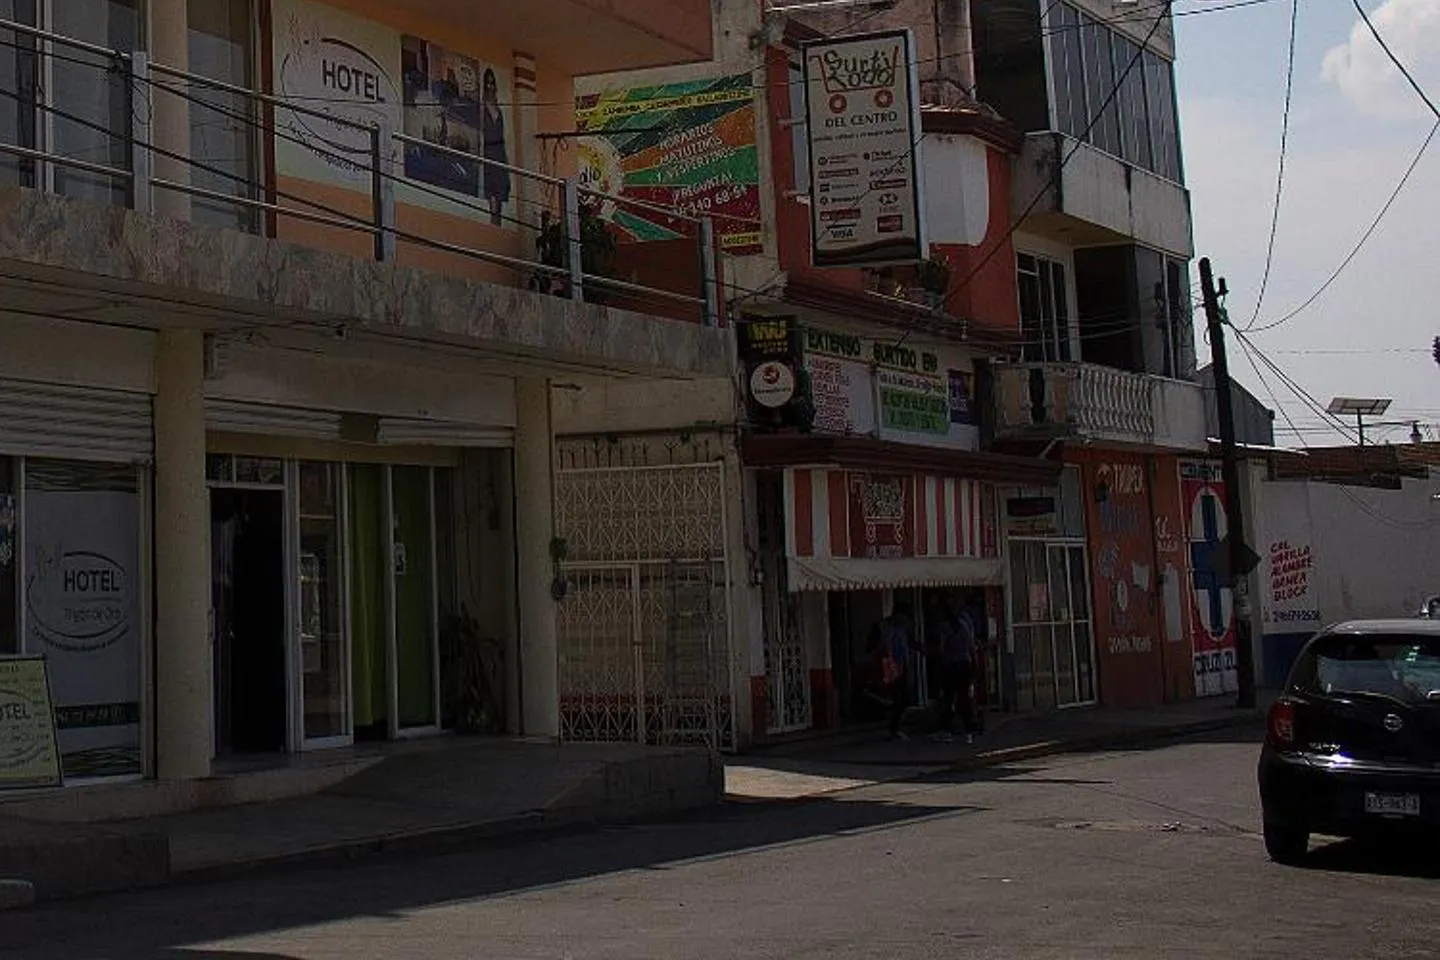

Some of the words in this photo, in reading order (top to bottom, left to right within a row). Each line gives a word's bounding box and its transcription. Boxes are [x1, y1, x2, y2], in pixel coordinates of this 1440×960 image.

[322, 59, 385, 103] HOTEL
[825, 116, 847, 128] DEL
[850, 111, 898, 127] CENTRO
[64, 569, 120, 592] HOTEL
